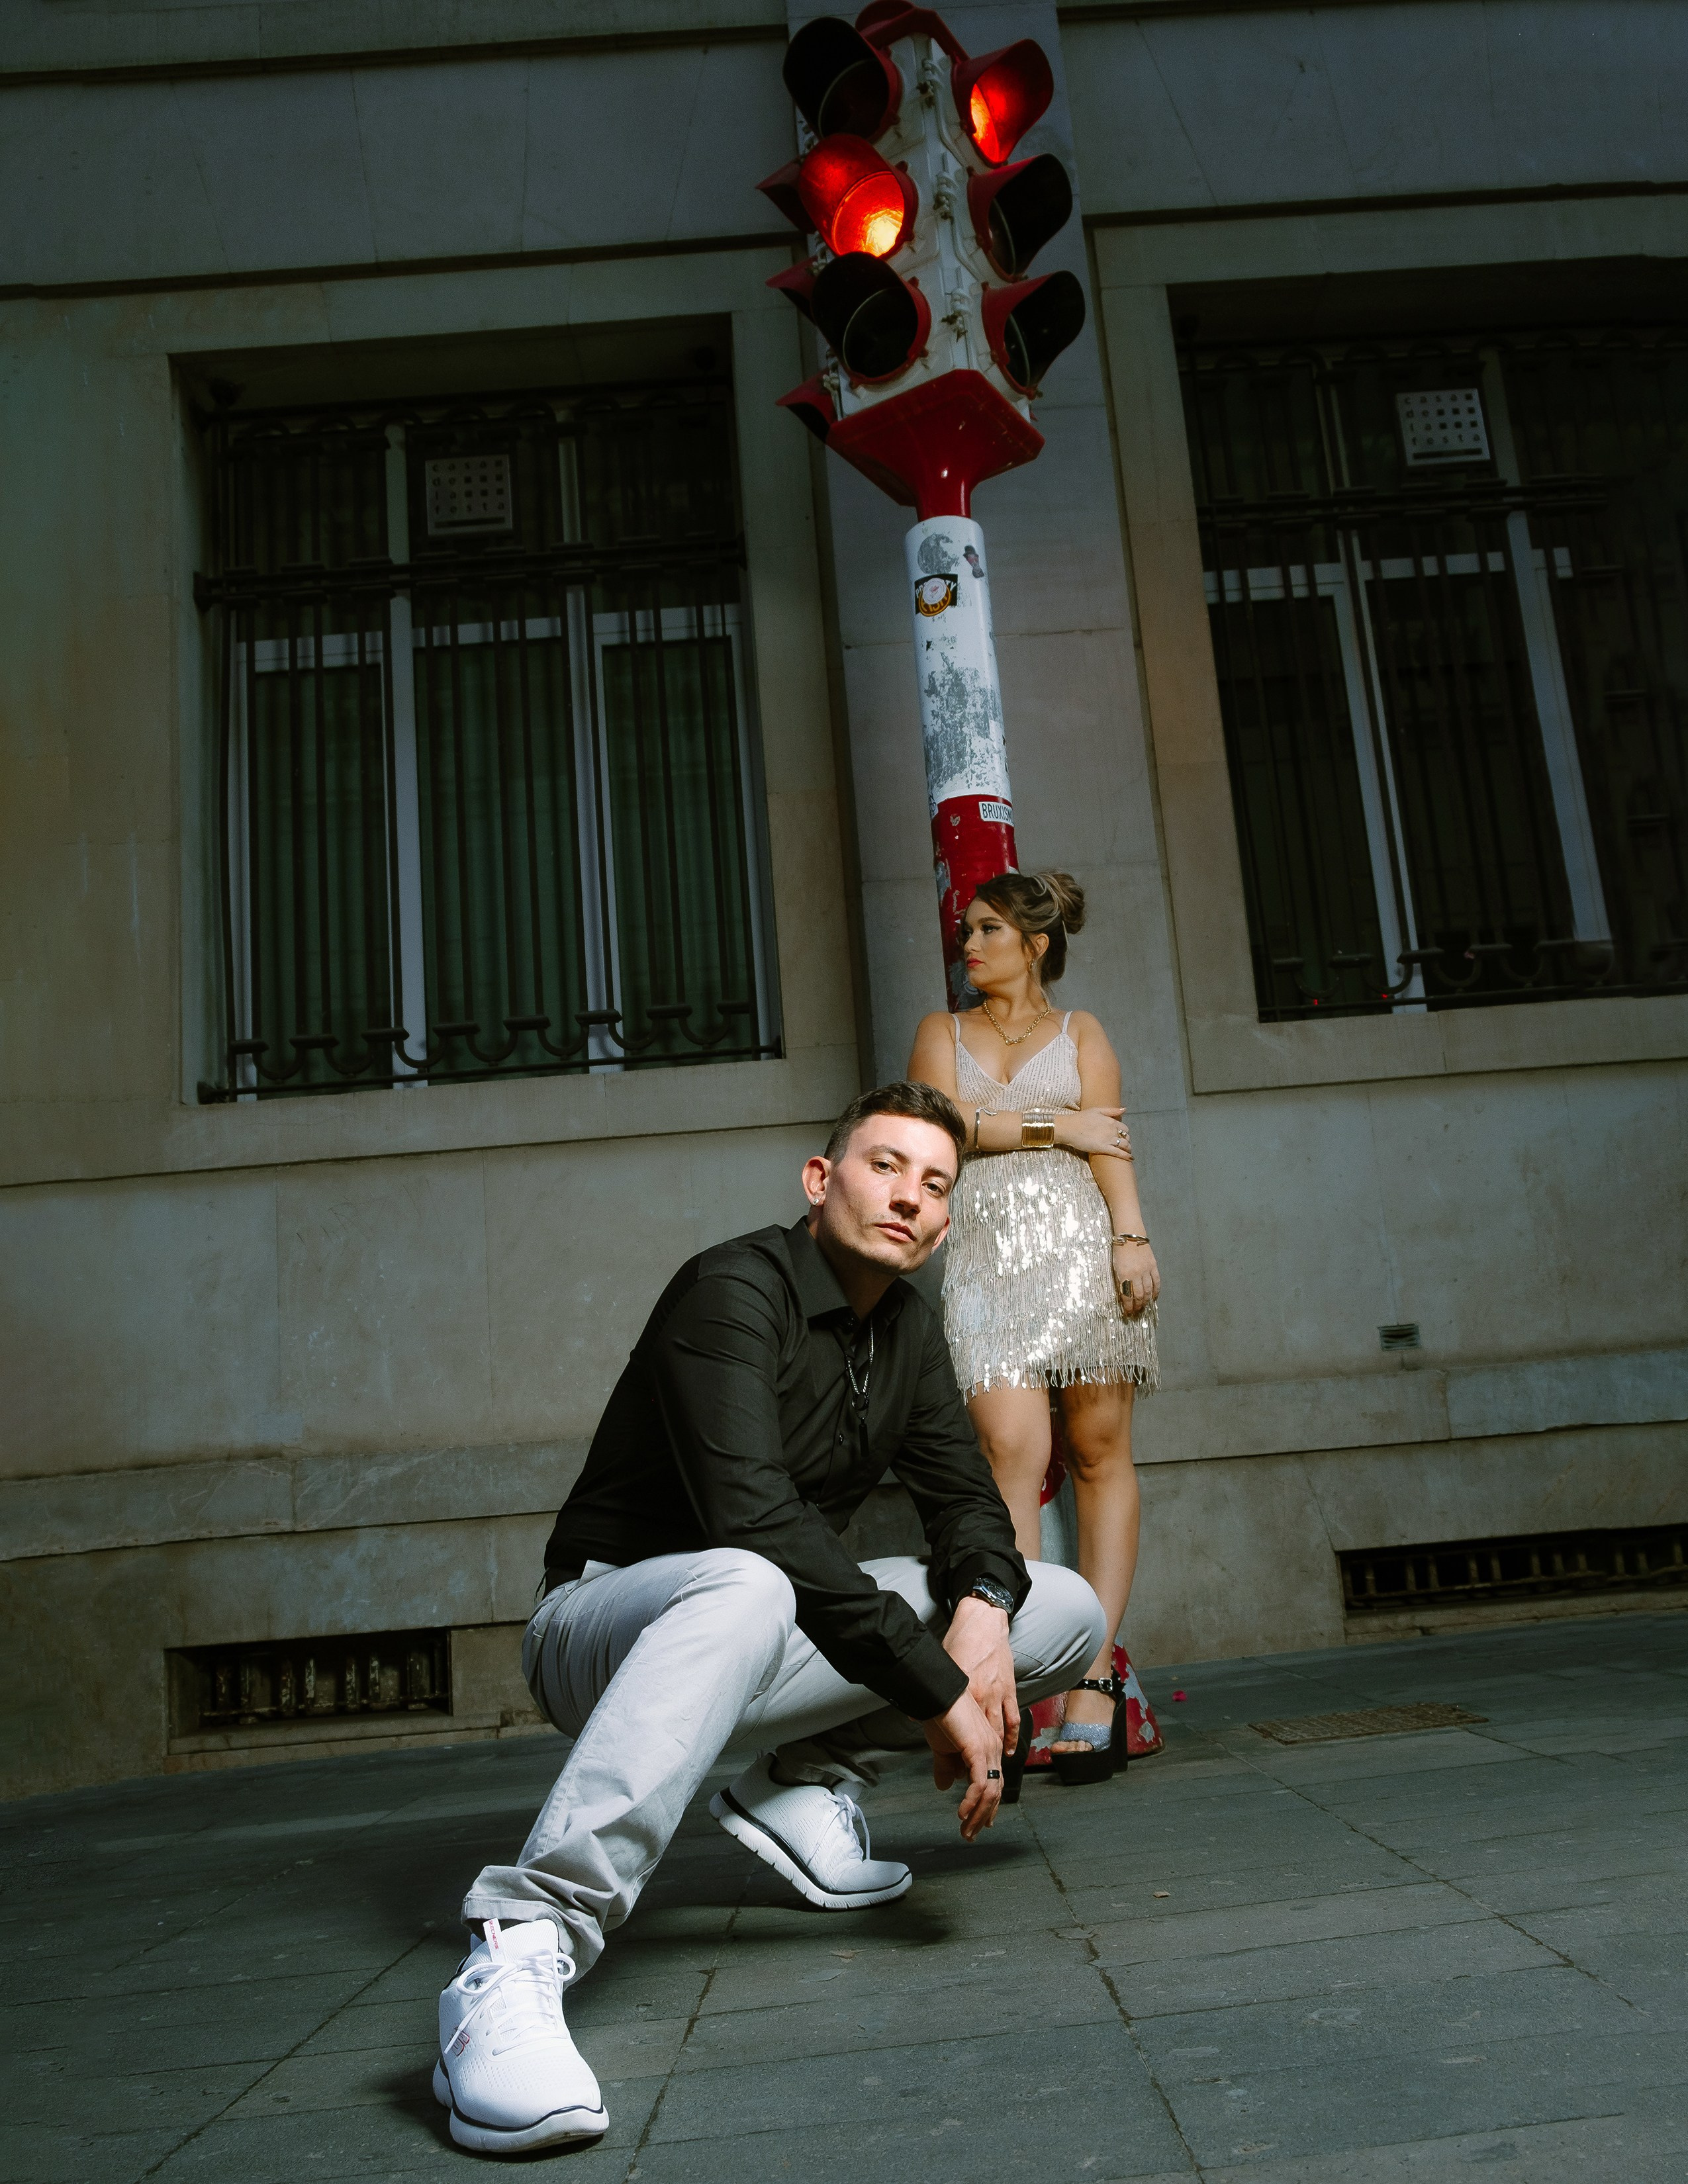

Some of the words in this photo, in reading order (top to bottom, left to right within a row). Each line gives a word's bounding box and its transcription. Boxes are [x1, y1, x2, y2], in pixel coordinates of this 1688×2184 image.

[1404, 394, 1458, 404] casa
[1406, 408, 1430, 418] de
[1410, 422, 1432, 432] la
[1411, 433, 1481, 445] festa
[432, 460, 487, 472] casa
[432, 476, 455, 486] de
[435, 491, 456, 500] la
[435, 502, 504, 514] festa
[915, 580, 957, 598] PRTY
